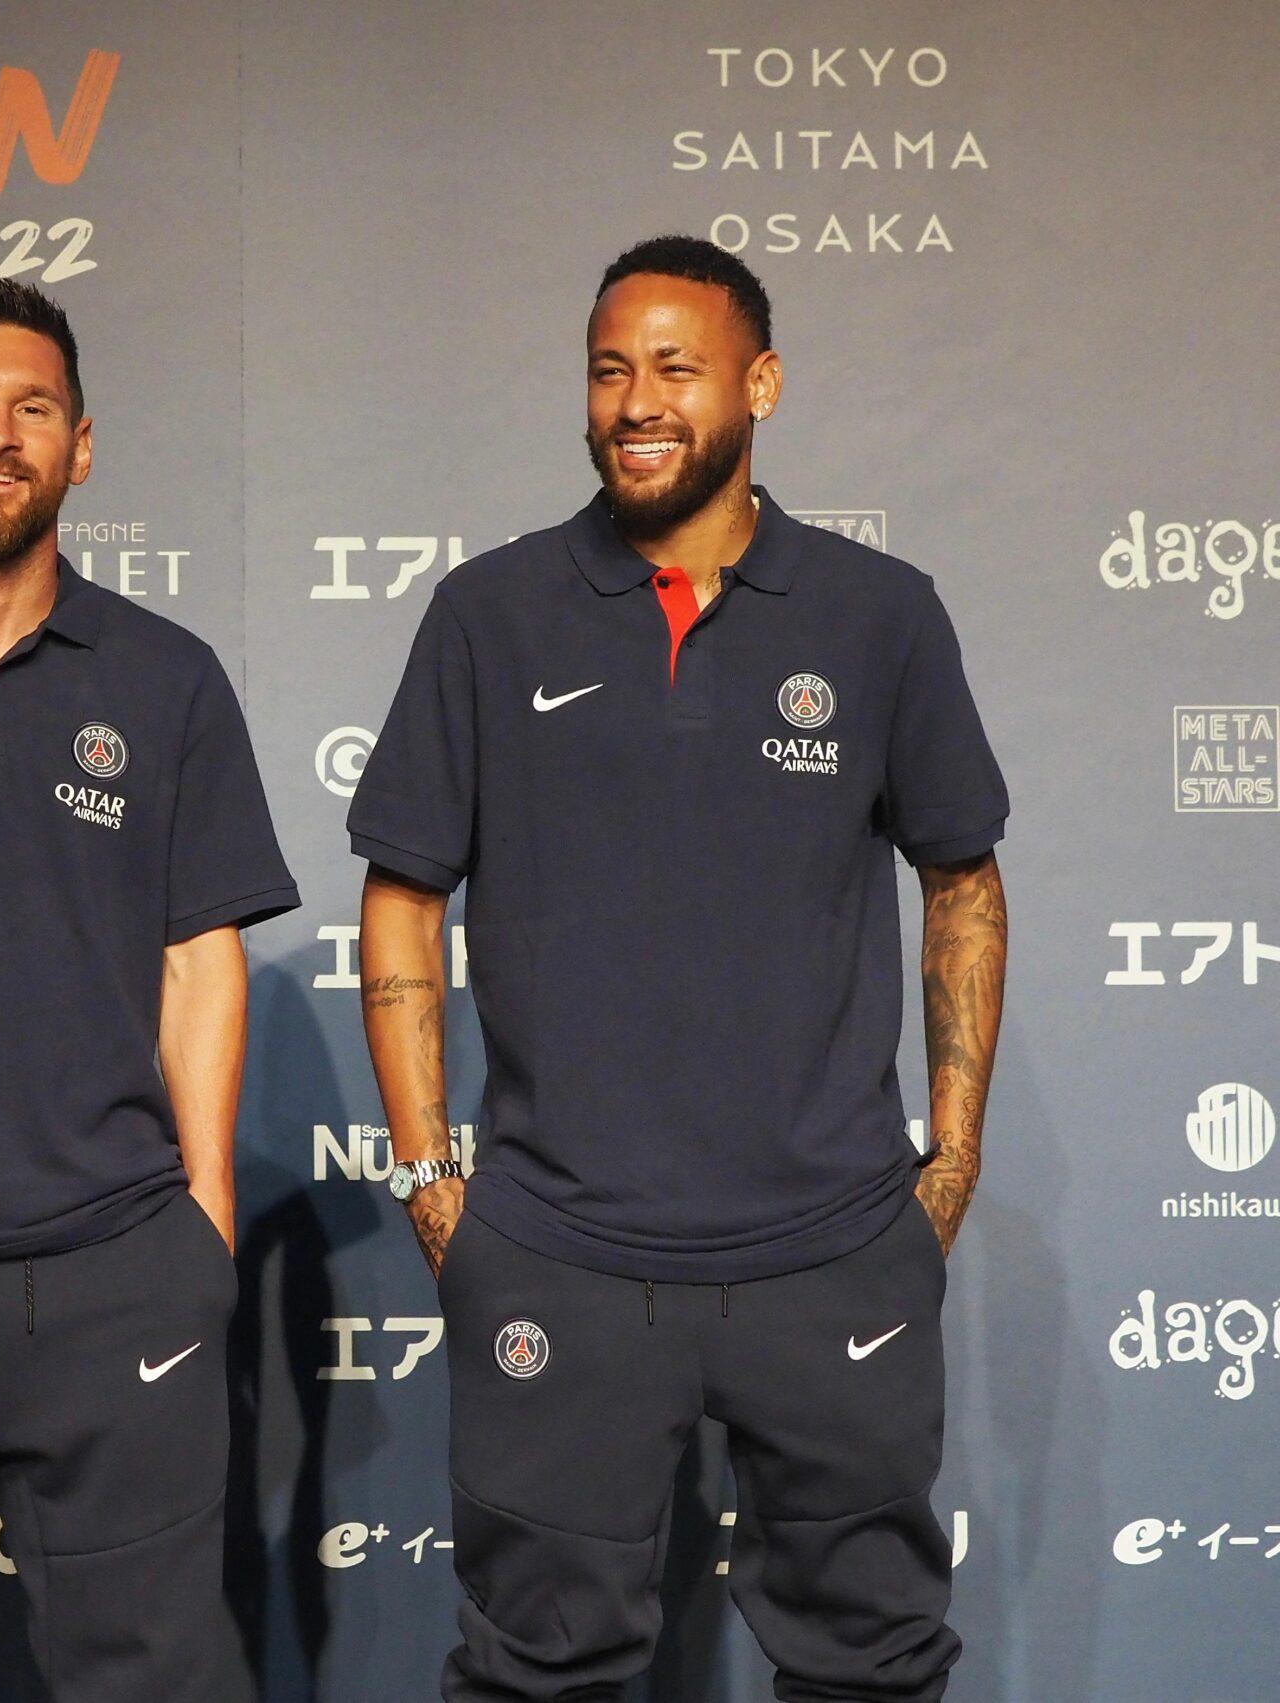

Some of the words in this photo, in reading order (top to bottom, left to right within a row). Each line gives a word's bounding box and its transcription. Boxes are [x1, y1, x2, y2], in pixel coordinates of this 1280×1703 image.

[706, 47, 948, 88] TOKYO
[672, 130, 989, 171] SAITAMA
[709, 212, 954, 253] OSAKA
[57, 522, 146, 542] PAGNE
[1100, 510, 1280, 619] dag
[787, 676, 824, 692] PARIS
[83, 729, 117, 744] PARIS
[1180, 714, 1275, 741] META
[761, 738, 839, 763] QATAR
[781, 759, 838, 775] AIRWAYS
[55, 783, 126, 817] QATAR
[1180, 777, 1275, 804] STARS
[73, 805, 122, 830] AIRWAYS
[1104, 922, 1280, 985] エアト
[1162, 1192, 1280, 1218] nishikaw
[506, 1324, 541, 1341] PARIS
[1109, 1289, 1280, 1400] dag
[316, 1317, 445, 1380] エア
